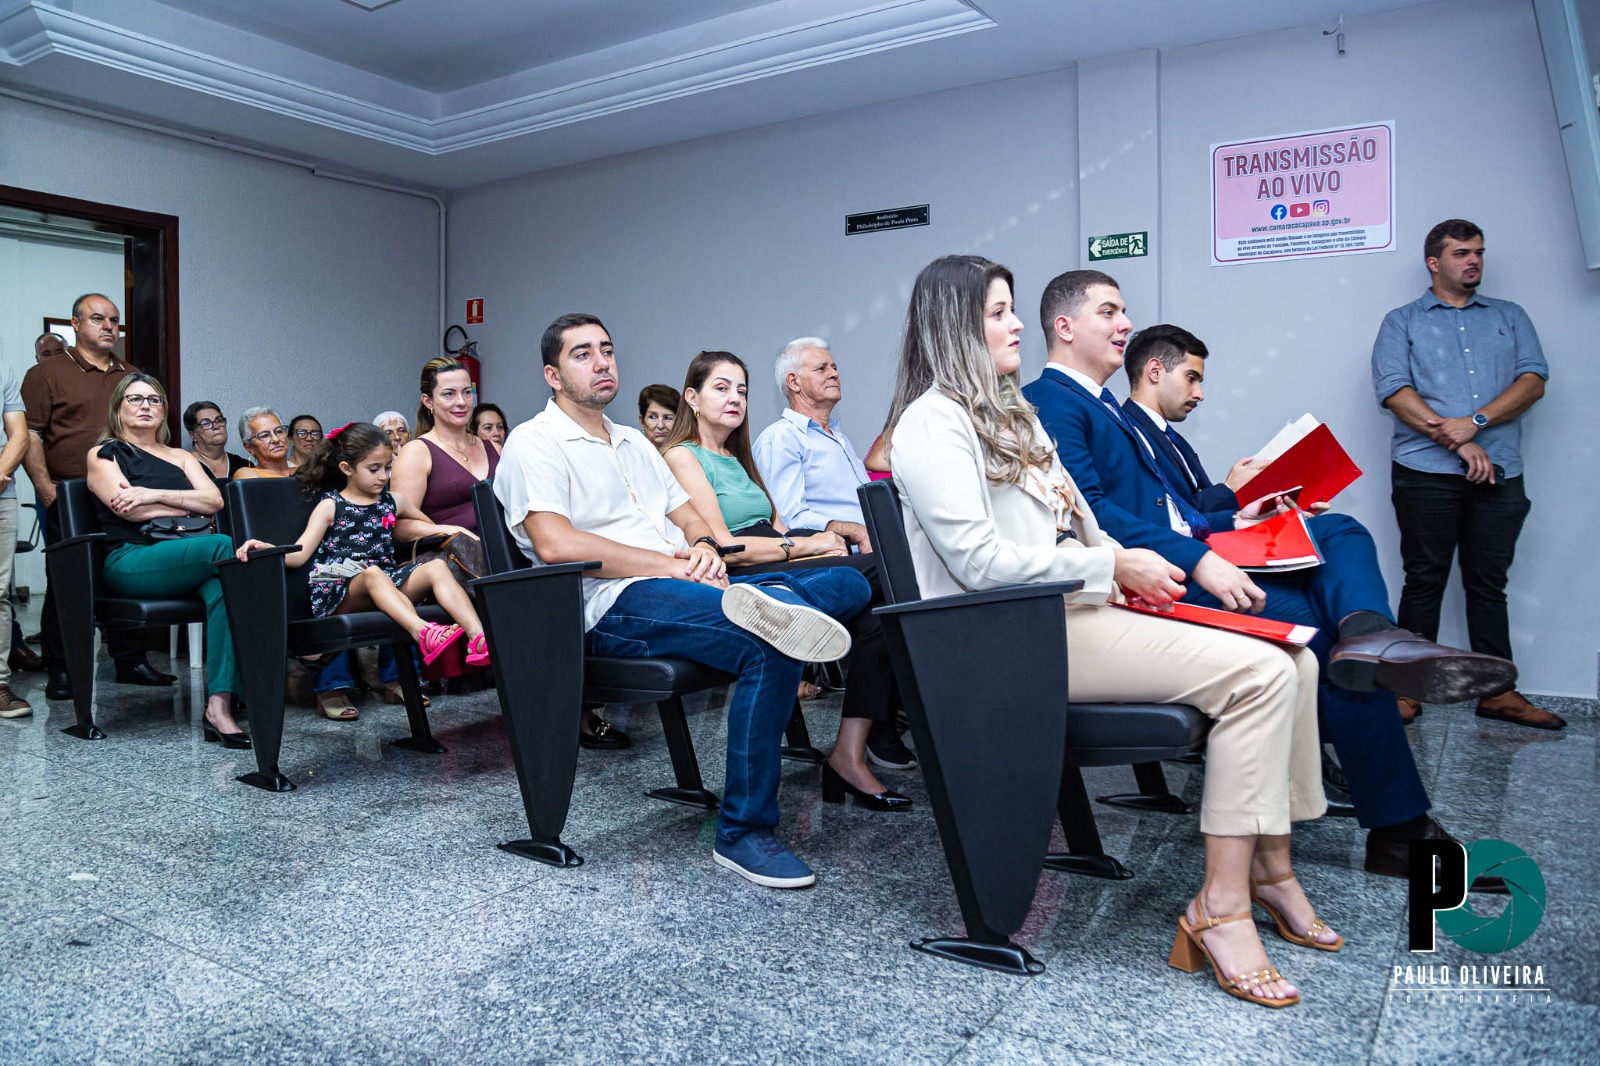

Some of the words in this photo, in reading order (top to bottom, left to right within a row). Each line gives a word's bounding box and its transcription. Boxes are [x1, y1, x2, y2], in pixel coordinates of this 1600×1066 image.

[1223, 136, 1377, 177] TRANSMISSÃO
[1257, 176, 1285, 200] AO
[1290, 170, 1341, 196] VIVO
[1102, 237, 1119, 248] SAÍDA
[1120, 237, 1129, 246] DE
[1102, 247, 1128, 256] EMERGÊNCIA
